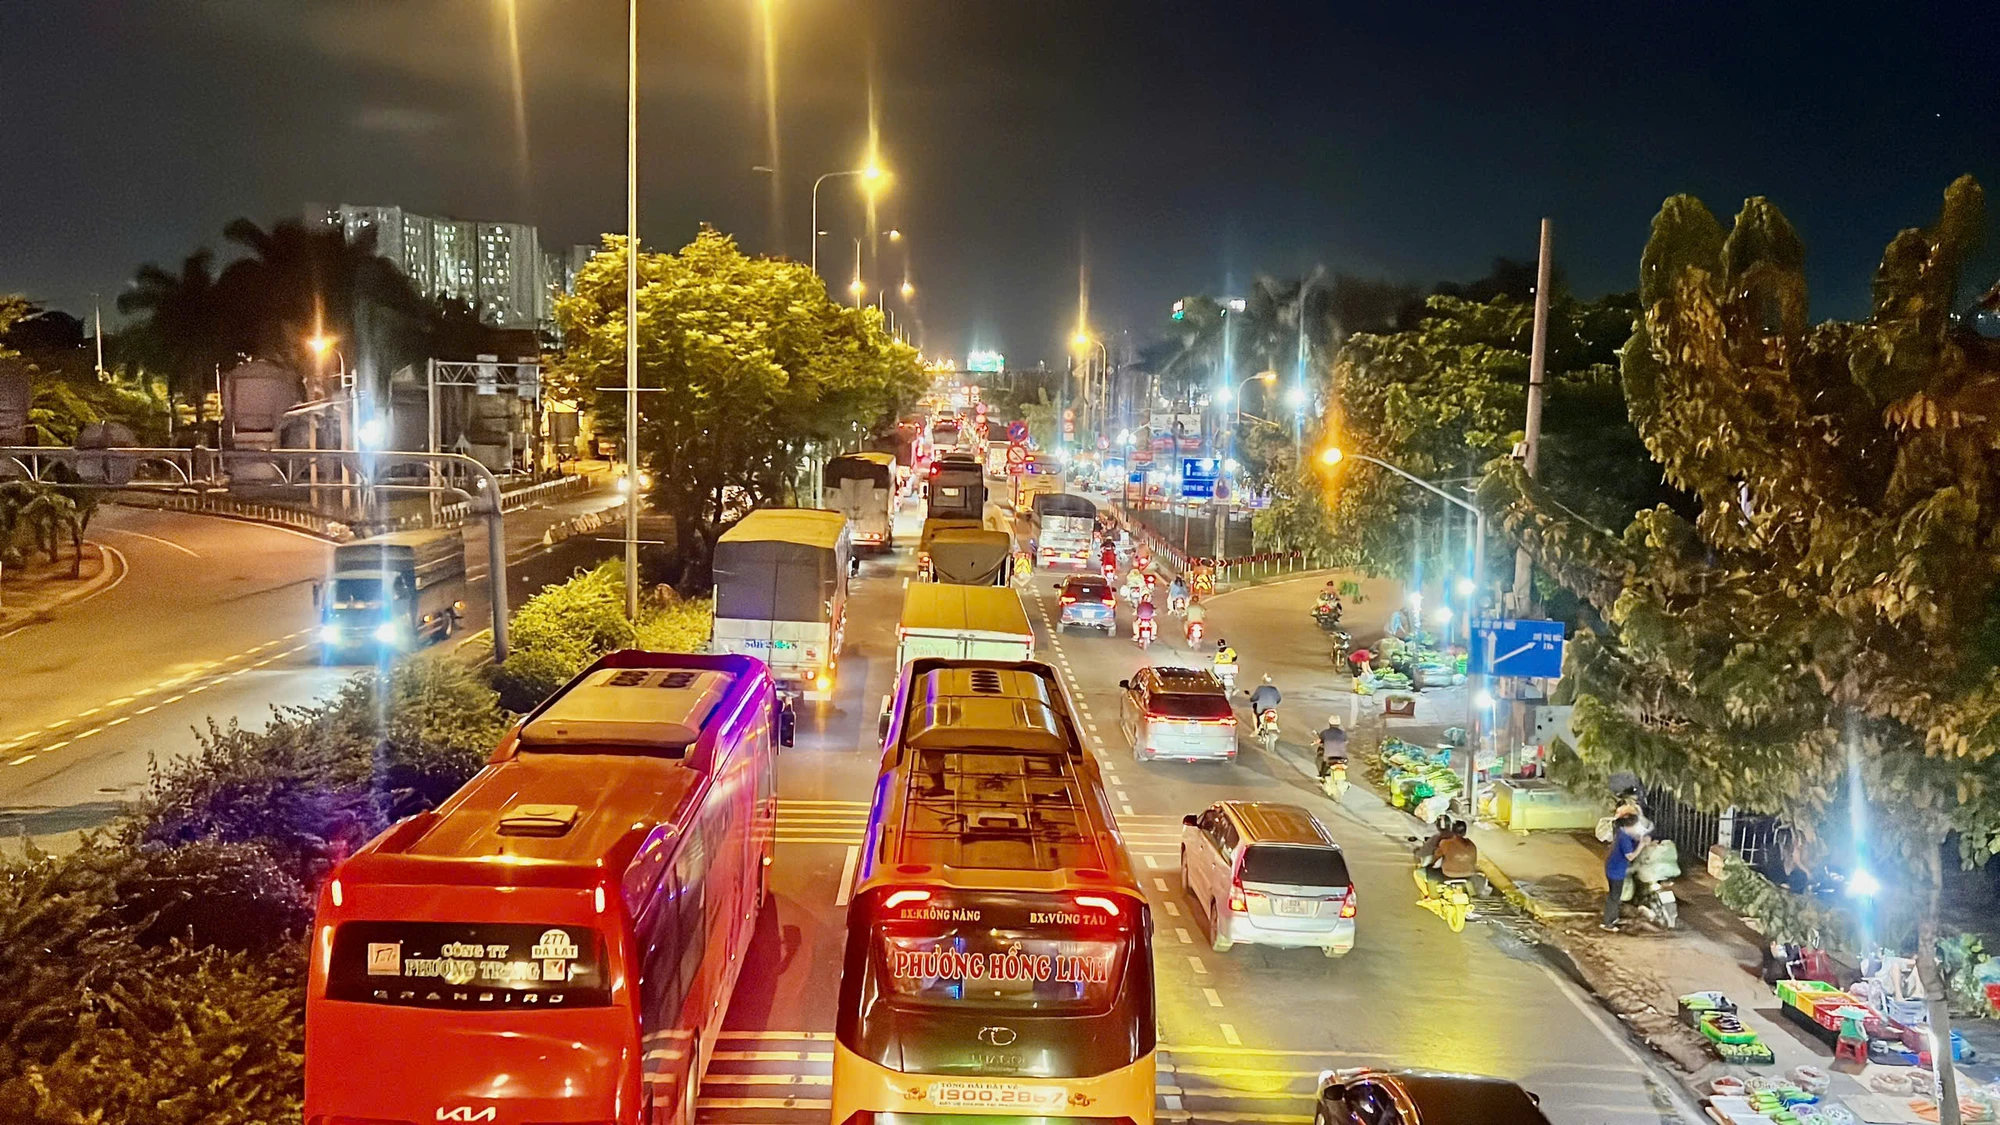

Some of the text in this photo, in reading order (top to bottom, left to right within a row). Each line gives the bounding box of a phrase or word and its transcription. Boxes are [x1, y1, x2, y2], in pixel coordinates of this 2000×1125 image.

[543, 933, 566, 945] 277
[441, 941, 510, 958] CÔNG TY
[404, 957, 477, 979] PHƯƠNG
[894, 941, 1109, 983] PHƯƠNG HỒNG LINH
[436, 1106, 497, 1122] KIA
